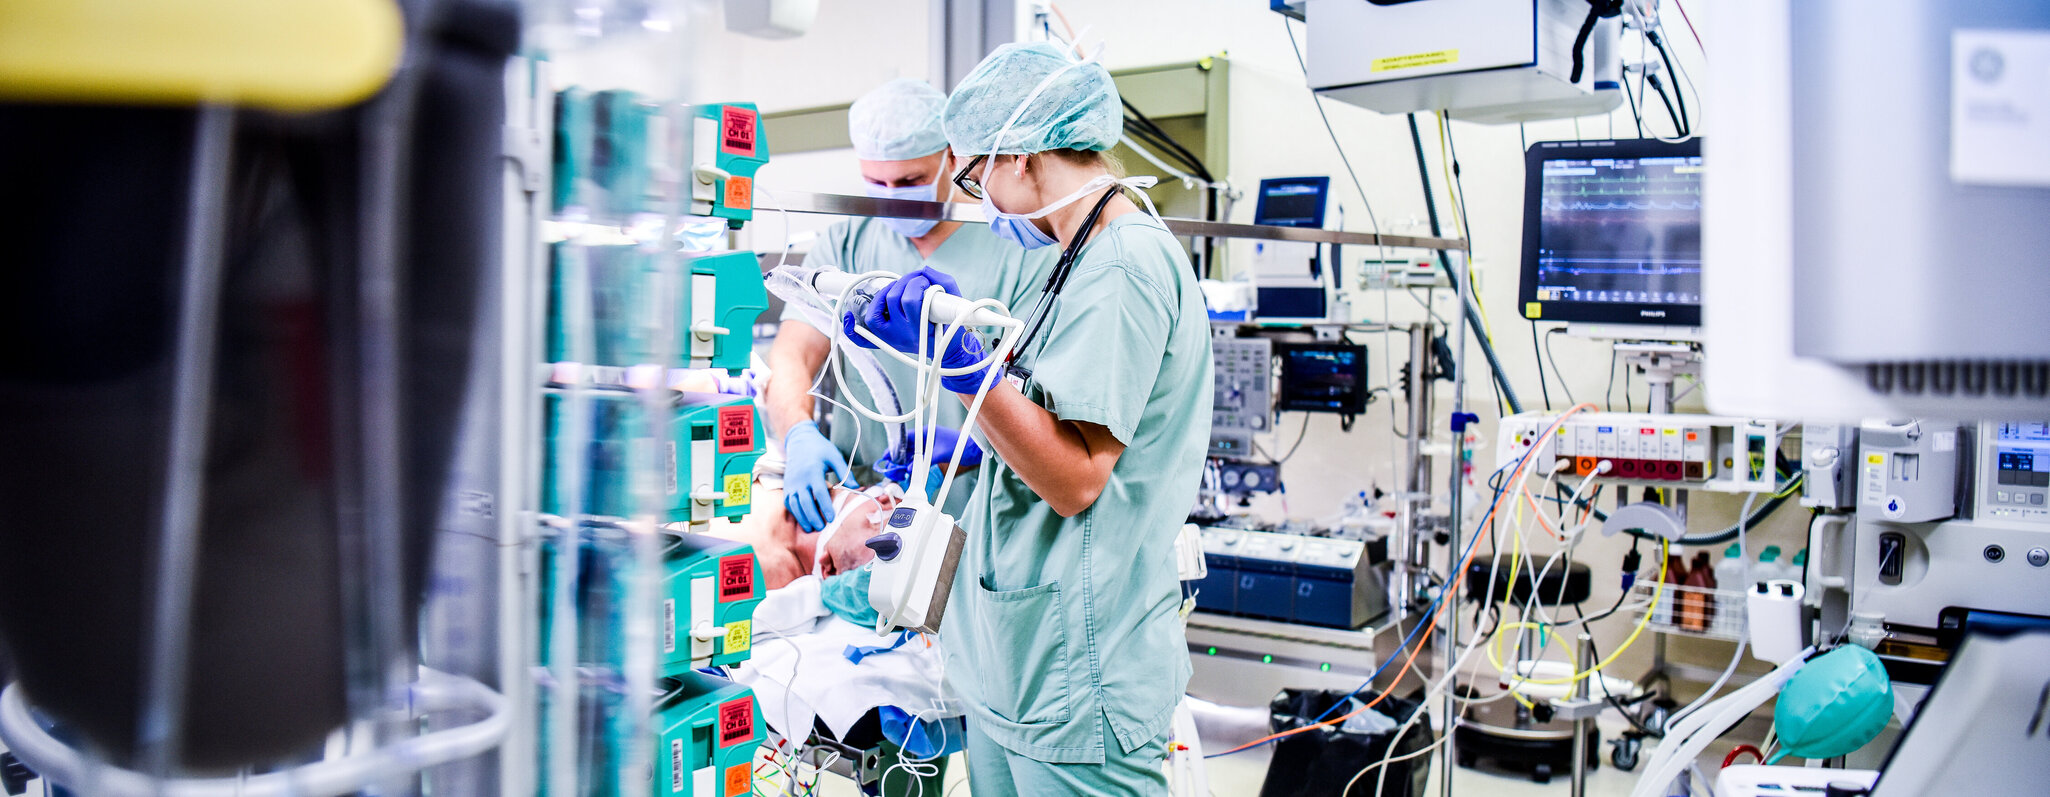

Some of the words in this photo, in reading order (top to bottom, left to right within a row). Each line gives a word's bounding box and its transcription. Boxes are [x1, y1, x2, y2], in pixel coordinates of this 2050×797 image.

[728, 128, 739, 138] CH
[740, 130, 750, 140] 01
[725, 428, 736, 437] CH
[738, 427, 747, 436] 01
[726, 577, 736, 586] CH
[738, 575, 747, 584] 01
[726, 721, 736, 731] CH
[738, 718, 747, 727] 01
